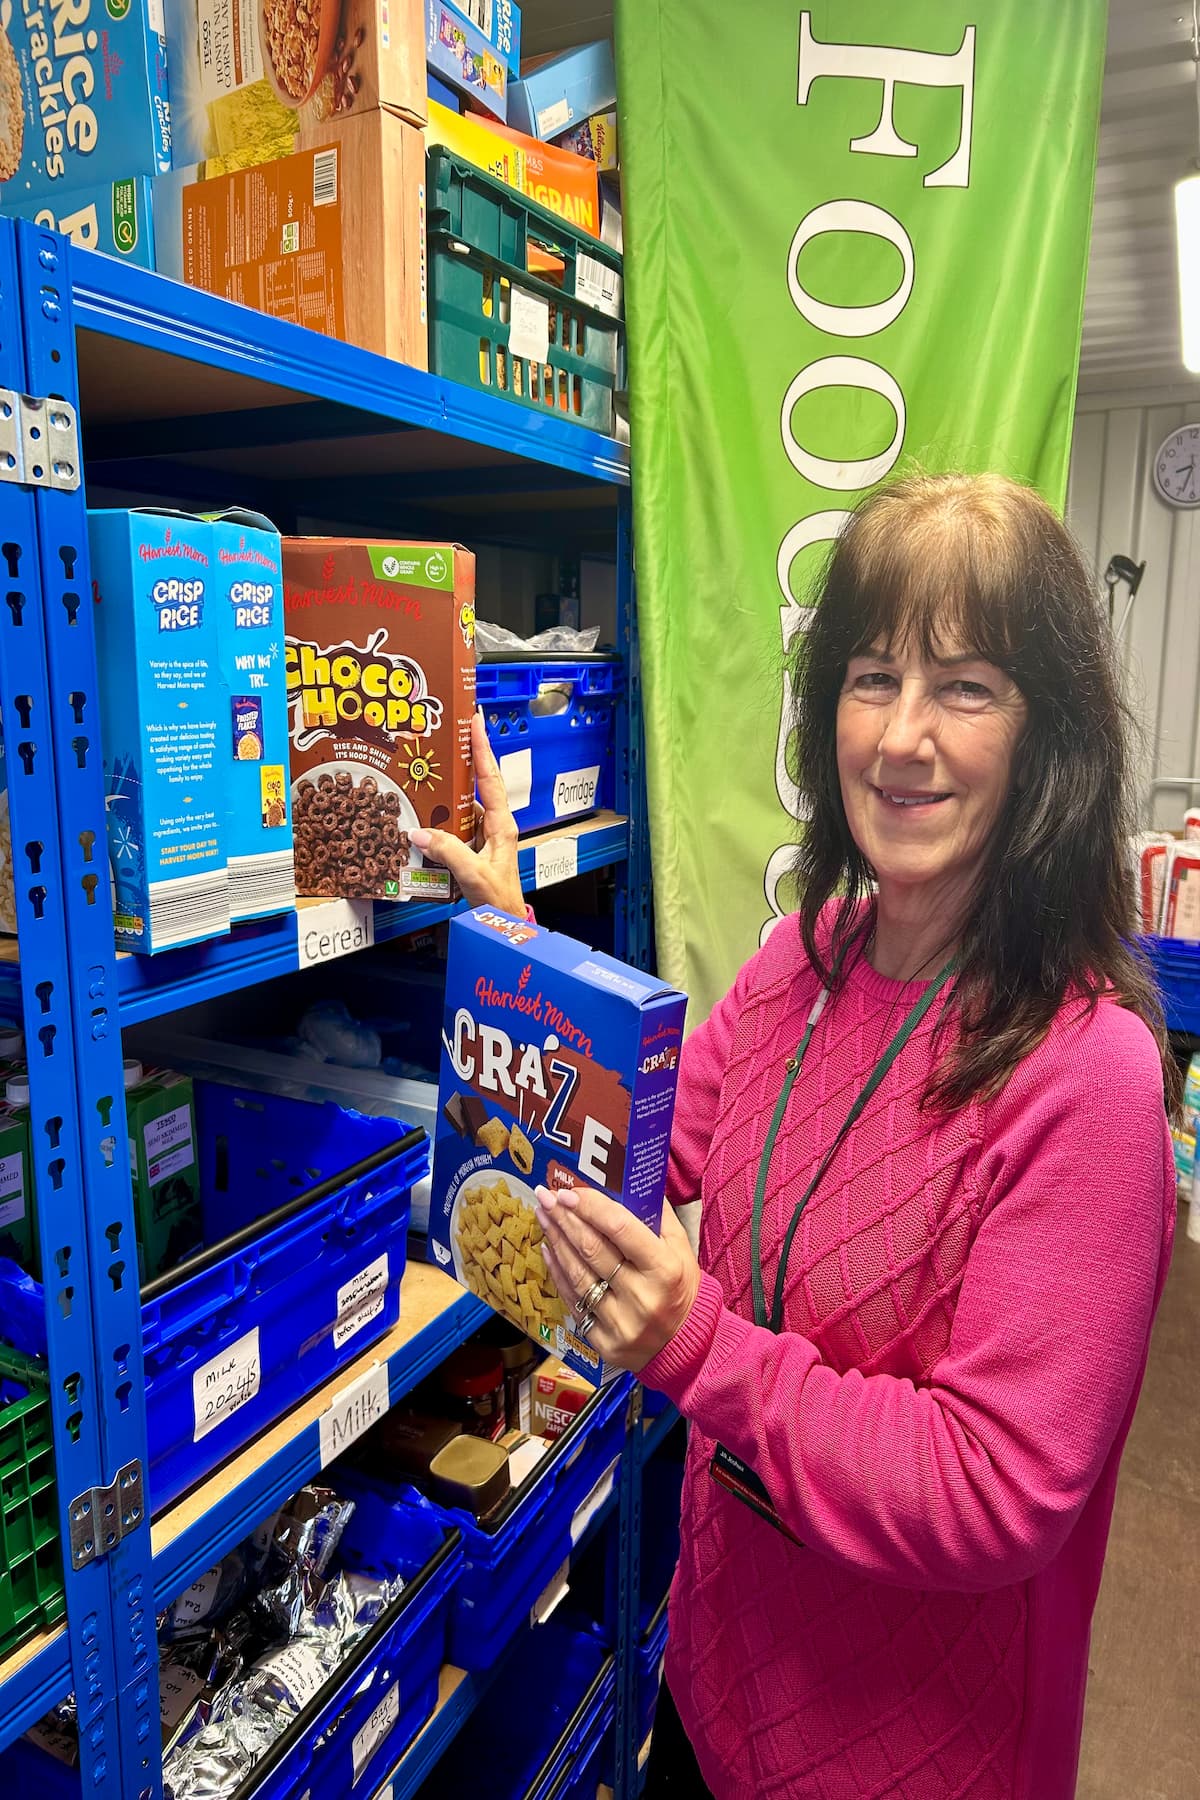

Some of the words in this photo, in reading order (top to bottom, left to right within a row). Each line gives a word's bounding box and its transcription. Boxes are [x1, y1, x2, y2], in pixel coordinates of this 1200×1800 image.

[213, 0, 221, 26] NU
[202, 20, 210, 69] TESCO
[214, 31, 223, 84] HONEY
[222, 43, 231, 88] CORN
[50, 0, 98, 152] Rice
[1176, 436, 1183, 446] 11
[1190, 428, 1199, 439] 12
[1165, 448, 1176, 458] 10
[1160, 463, 1167, 472] 9
[1164, 478, 1170, 488] 8
[1189, 491, 1196, 499] 6
[138, 543, 182, 564] Harvest
[183, 543, 209, 568] Morn
[218, 547, 253, 565] Harvest
[253, 553, 278, 573] Morn
[153, 579, 204, 603] CRISP
[230, 583, 274, 604] CRISP
[360, 580, 423, 621] Morn
[159, 605, 199, 630] RICE
[236, 605, 270, 627] RICE
[149, 660, 168, 671] Variety
[173, 660, 181, 668] the
[182, 660, 194, 670] spice
[234, 654, 256, 671] WHY
[257, 654, 271, 669] NOT
[161, 671, 172, 680] they
[146, 723, 163, 732] Which
[169, 722, 179, 732] why
[187, 722, 199, 730] have
[237, 720, 257, 731] FLAKES
[150, 734, 170, 743] created
[179, 733, 199, 741] delicious
[155, 744, 178, 753] satisfying
[179, 744, 192, 752] range
[193, 742, 199, 750] of
[156, 755, 174, 763] making
[175, 753, 191, 763] variety
[191, 753, 203, 761] easy
[333, 742, 351, 751] RISE
[352, 742, 368, 753] AND
[369, 746, 392, 764] SHINE
[335, 750, 348, 759] IT'S
[349, 751, 368, 763] HOOP
[368, 756, 388, 770] TIME!
[182, 763, 190, 771] for
[198, 762, 212, 770] whole
[168, 774, 184, 783] family
[556, 777, 594, 806] Porridge
[160, 817, 174, 826] Using
[175, 815, 185, 824] only
[161, 846, 178, 856] START
[180, 843, 196, 852] YOUR
[196, 841, 207, 849] DAY
[207, 838, 217, 846] THE
[160, 855, 186, 866] HARVEST
[187, 851, 205, 860] MORN
[538, 856, 575, 880] Porridge
[303, 915, 369, 960] Cereal
[471, 910, 530, 945] CRAZE
[475, 975, 542, 1021] Harvest
[543, 1000, 594, 1058] Morn
[637, 1046, 677, 1074] CRAZE
[442, 1007, 613, 1187] CRAZE
[156, 1113, 176, 1130] TESCO
[161, 1121, 188, 1138] SKIMMED
[554, 1167, 575, 1187] MILK
[206, 1358, 237, 1388] MILK
[535, 1400, 577, 1427] NESC
